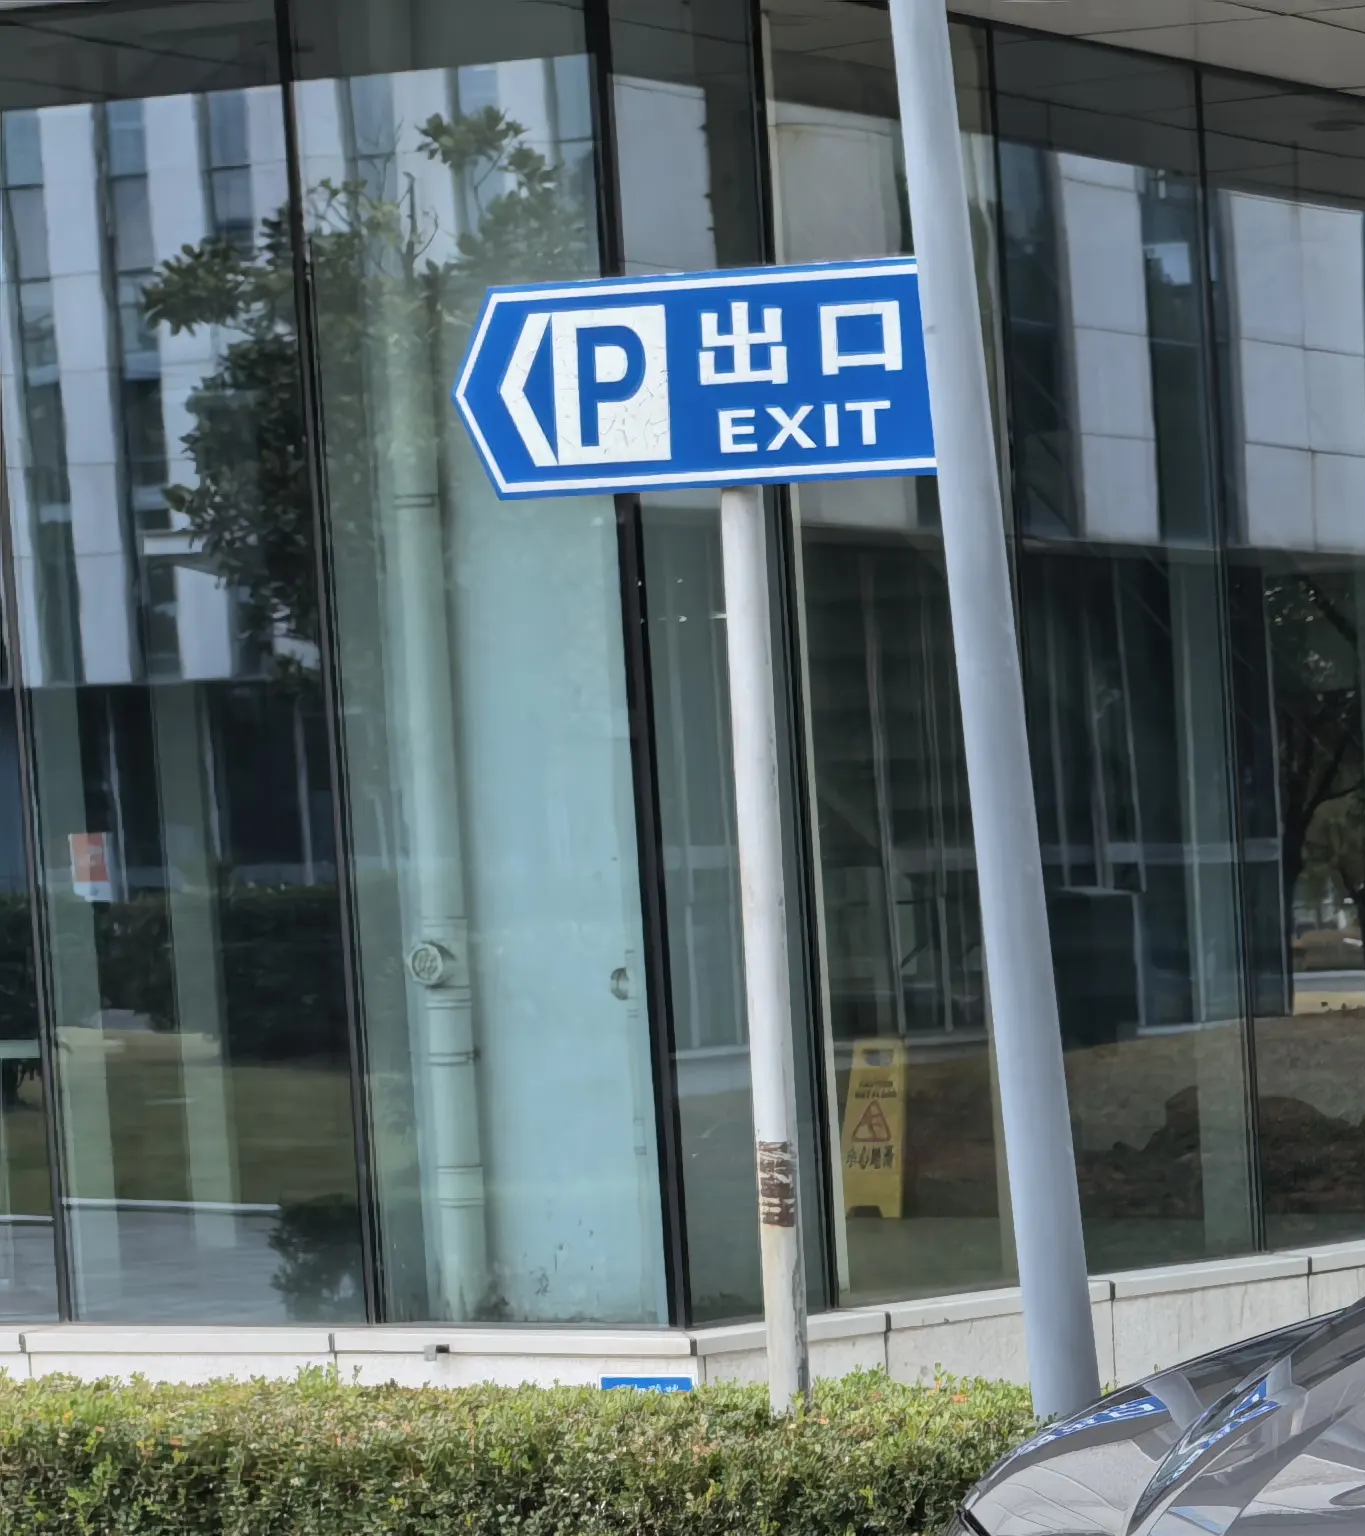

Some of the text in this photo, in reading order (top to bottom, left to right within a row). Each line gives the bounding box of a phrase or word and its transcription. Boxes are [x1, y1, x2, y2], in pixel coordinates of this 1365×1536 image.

[575, 324, 646, 448] P
[699, 300, 903, 386] 出口
[718, 400, 891, 454] EXIT
